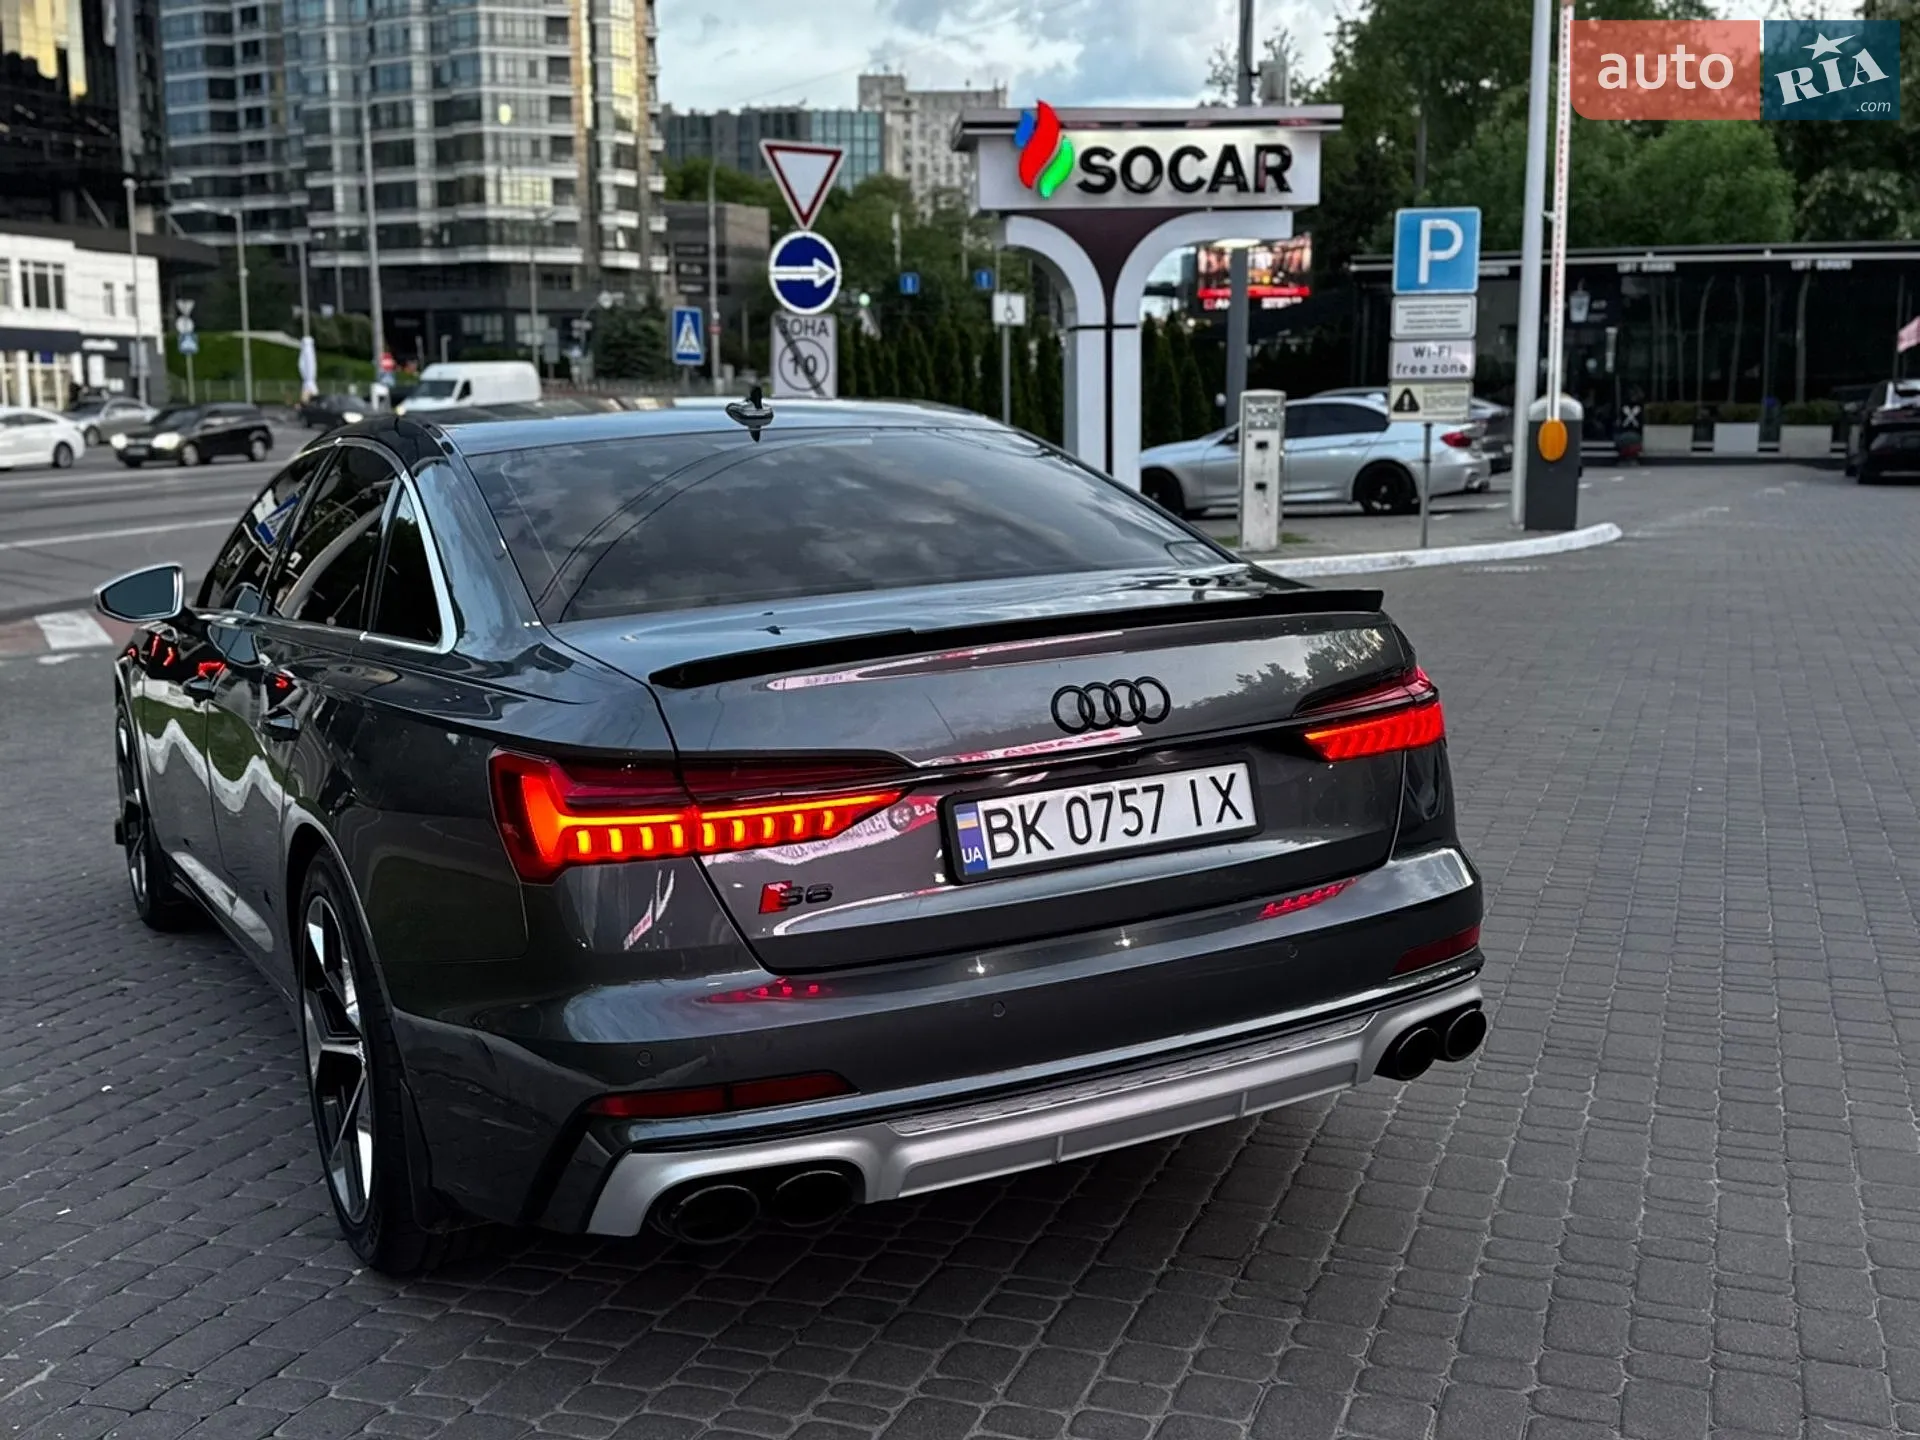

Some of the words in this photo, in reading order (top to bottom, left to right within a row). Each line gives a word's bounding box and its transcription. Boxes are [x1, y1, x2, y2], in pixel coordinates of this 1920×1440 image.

[1077, 144, 1293, 193] SOCAR
[1418, 218, 1464, 284] P
[1396, 362, 1428, 375] free
[1432, 363, 1468, 375] zone
[984, 801, 1055, 860] BK
[1065, 783, 1165, 845] 0757
[1190, 773, 1243, 826] IX
[962, 847, 983, 863] UA
[777, 882, 834, 908] S6
